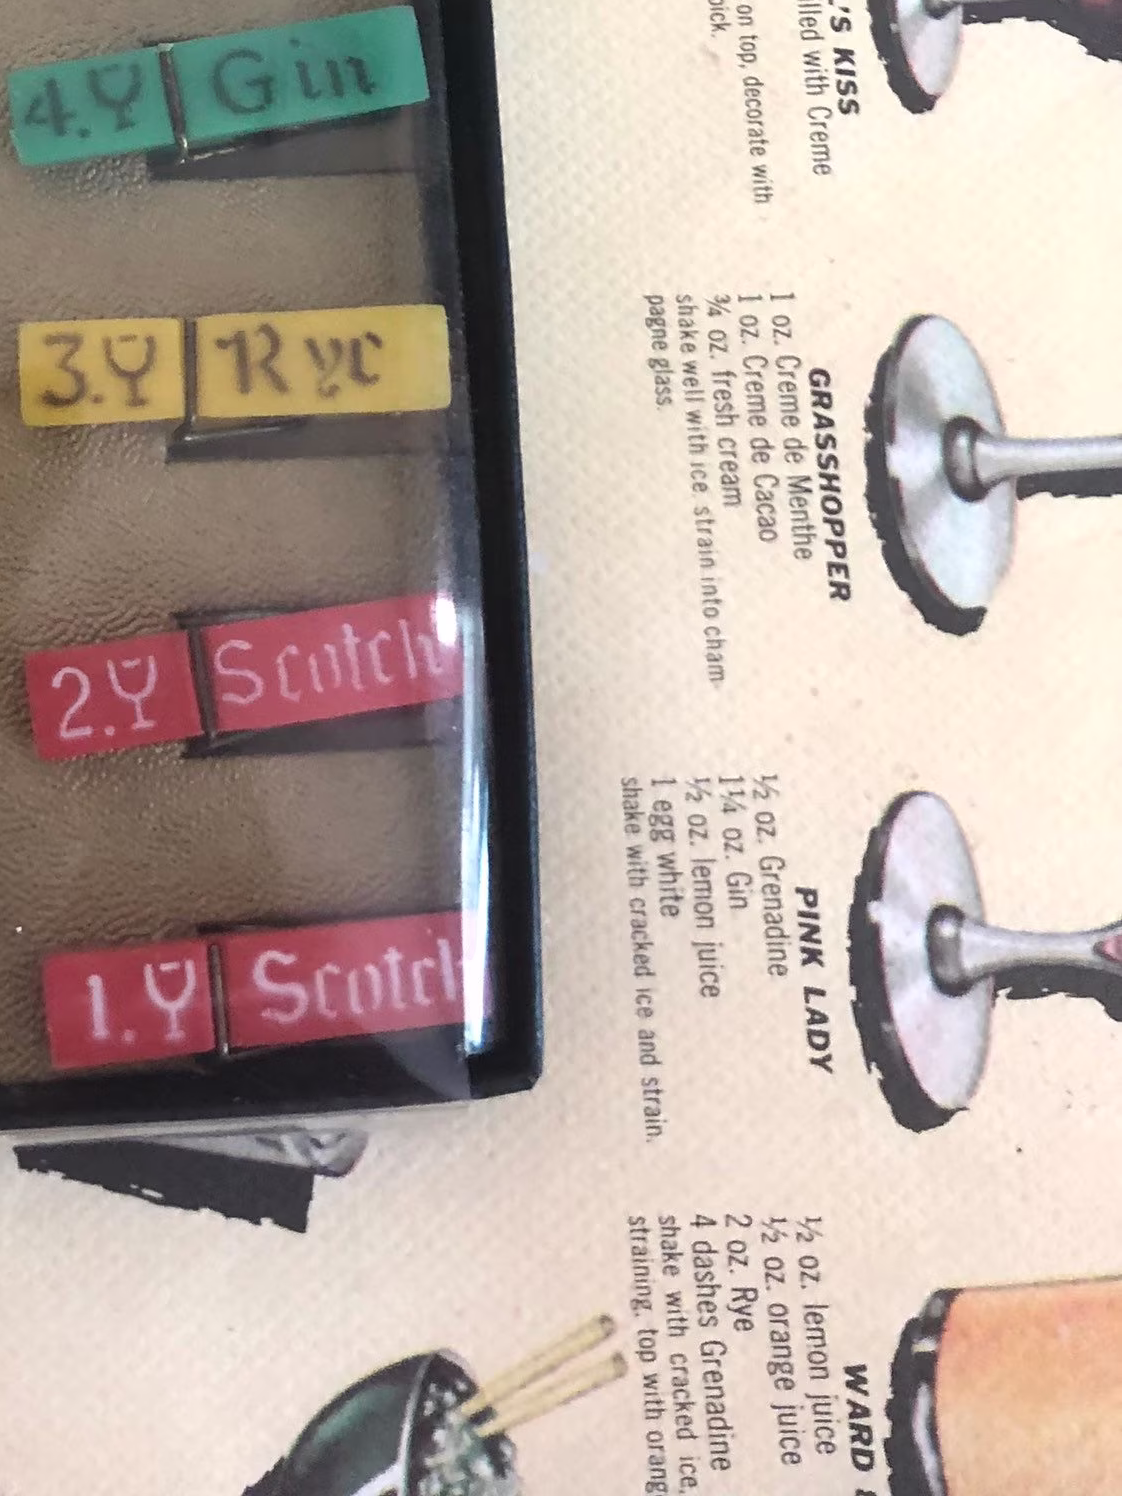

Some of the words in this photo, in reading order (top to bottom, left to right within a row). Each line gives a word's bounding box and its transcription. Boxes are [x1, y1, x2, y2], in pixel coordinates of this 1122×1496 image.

[212, 36, 379, 116] Gin
[802, 50, 828, 96] with
[832, 47, 860, 116] KISS
[742, 76, 770, 156] decorate
[806, 106, 832, 176] Creme
[752, 164, 774, 204] with
[214, 323, 385, 399] Rye
[742, 355, 768, 427] Creme
[775, 356, 800, 428] Creme
[712, 370, 739, 427] fresh
[717, 438, 742, 508] cream
[750, 438, 774, 464] de
[783, 438, 808, 464] de
[808, 367, 852, 602] GRASSHOPPER
[753, 474, 778, 544] Cacao
[786, 476, 814, 560] Menthe
[649, 800, 676, 843] egg
[657, 852, 682, 919] white
[690, 858, 716, 928] lemon
[726, 872, 751, 910] Gin
[758, 856, 788, 976] Grenadine
[794, 886, 825, 968] PINK
[691, 942, 722, 998] juice
[803, 986, 834, 1074] LADY
[658, 1215, 684, 1278] shake
[664, 1290, 689, 1338] with
[691, 1240, 720, 1328] dashes
[726, 1288, 758, 1332] Rye
[635, 1328, 658, 1362] top
[767, 1303, 796, 1390] orange
[802, 1304, 830, 1380] lemon
[642, 1373, 664, 1420] with
[669, 1354, 697, 1440] cracked
[700, 1340, 734, 1471] Grenadine
[806, 1395, 839, 1454] juice
[842, 1364, 875, 1472] WARD
[645, 1430, 668, 1496] orang
[770, 1405, 804, 1466] juice
